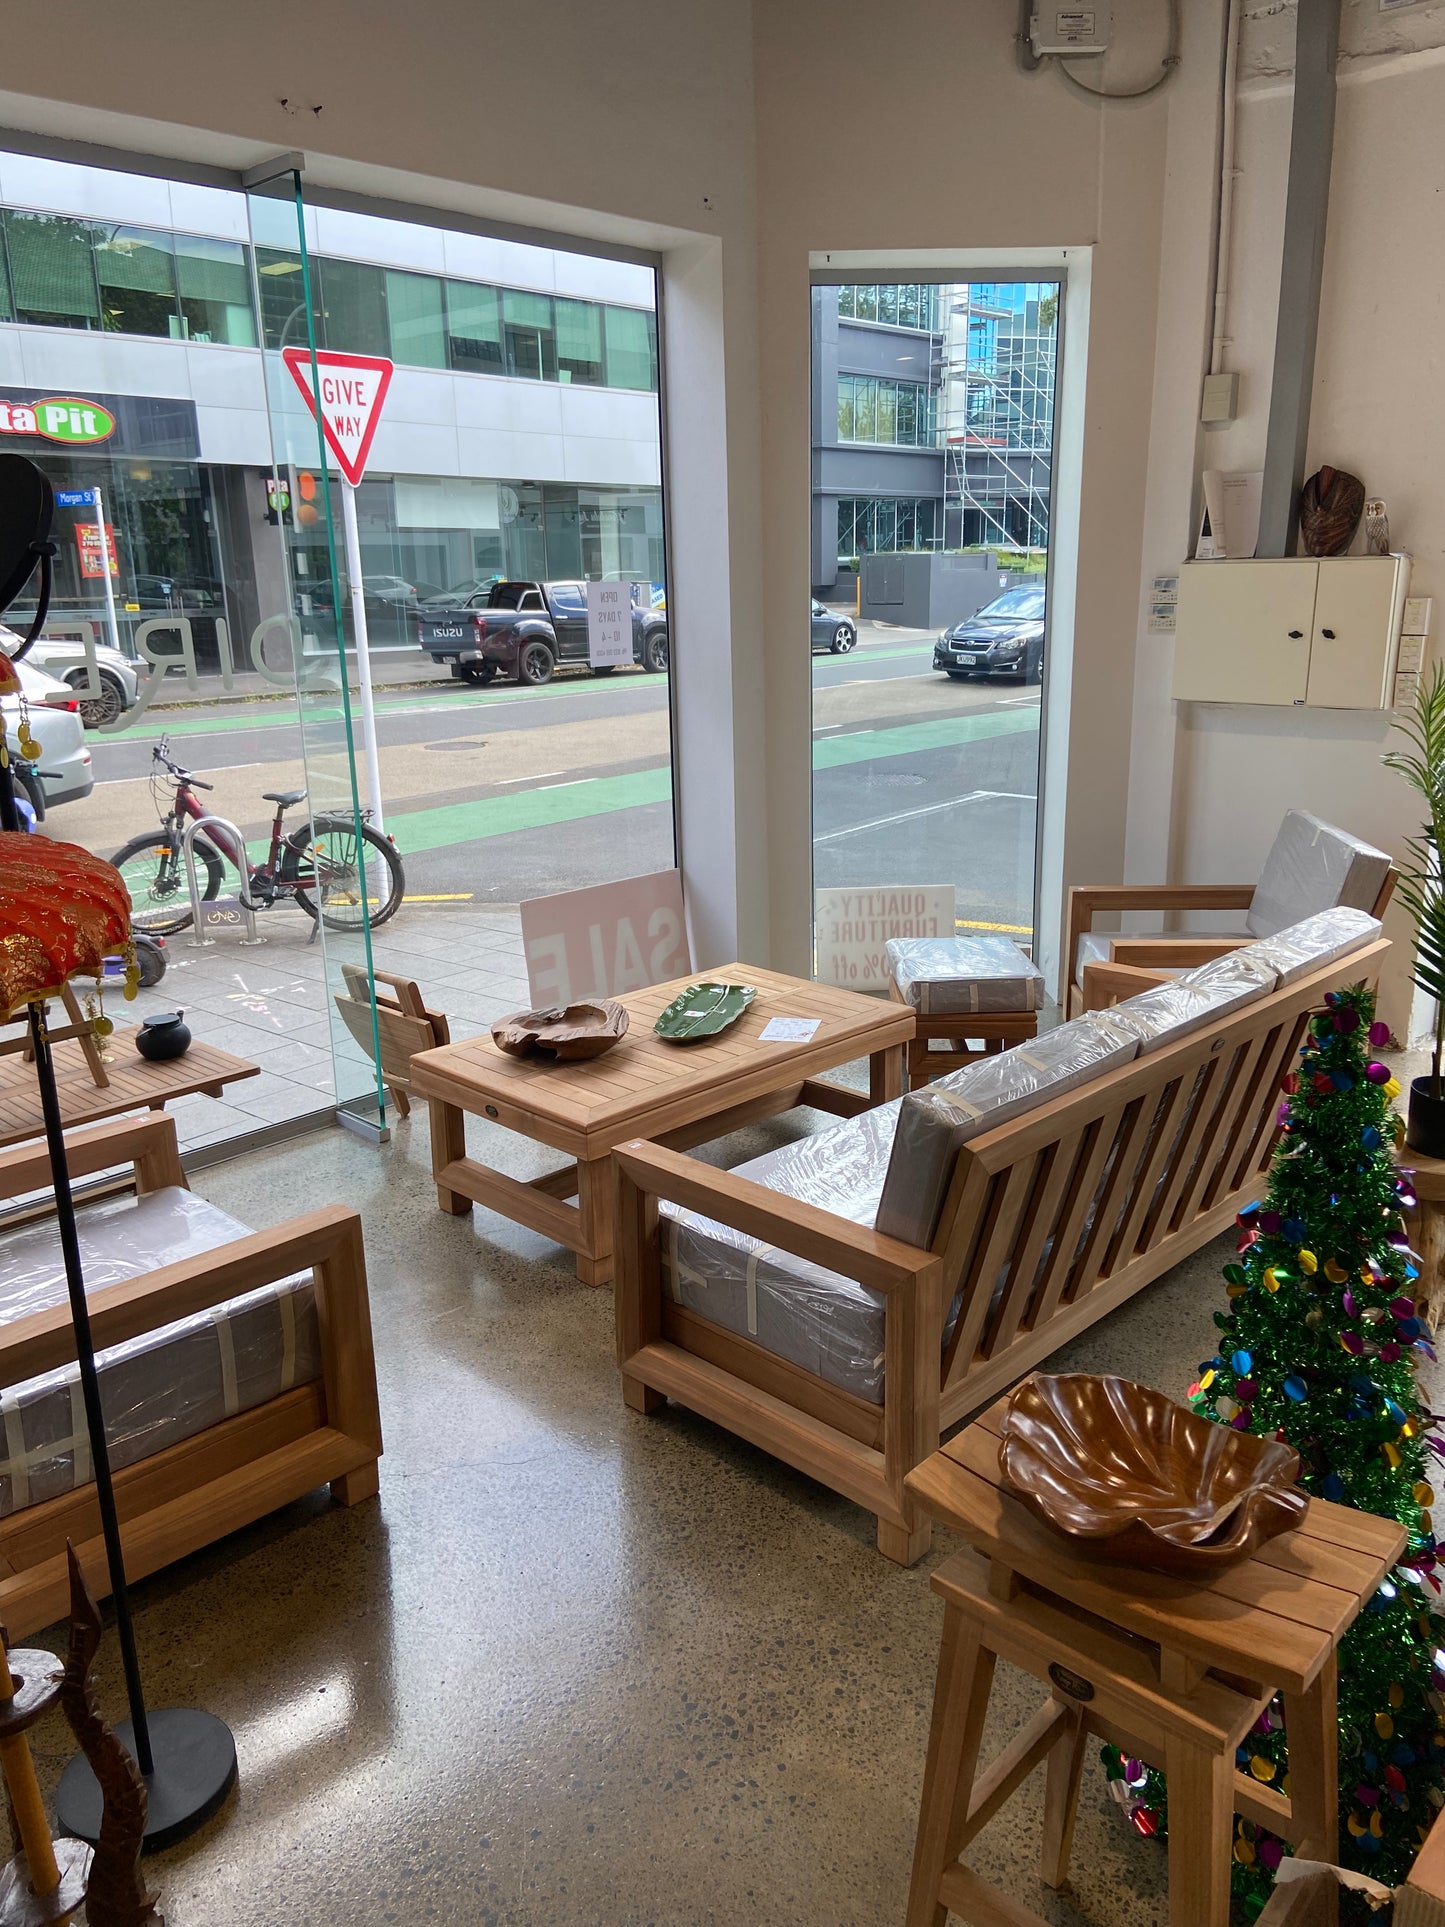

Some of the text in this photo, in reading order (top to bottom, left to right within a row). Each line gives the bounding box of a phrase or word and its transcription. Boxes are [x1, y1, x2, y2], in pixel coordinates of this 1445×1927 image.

[323, 378, 367, 406] GIVE
[45, 405, 98, 435] Pit
[334, 416, 361, 437] WAY
[60, 493, 83, 505] Morgan
[433, 628, 463, 638] ISUZU
